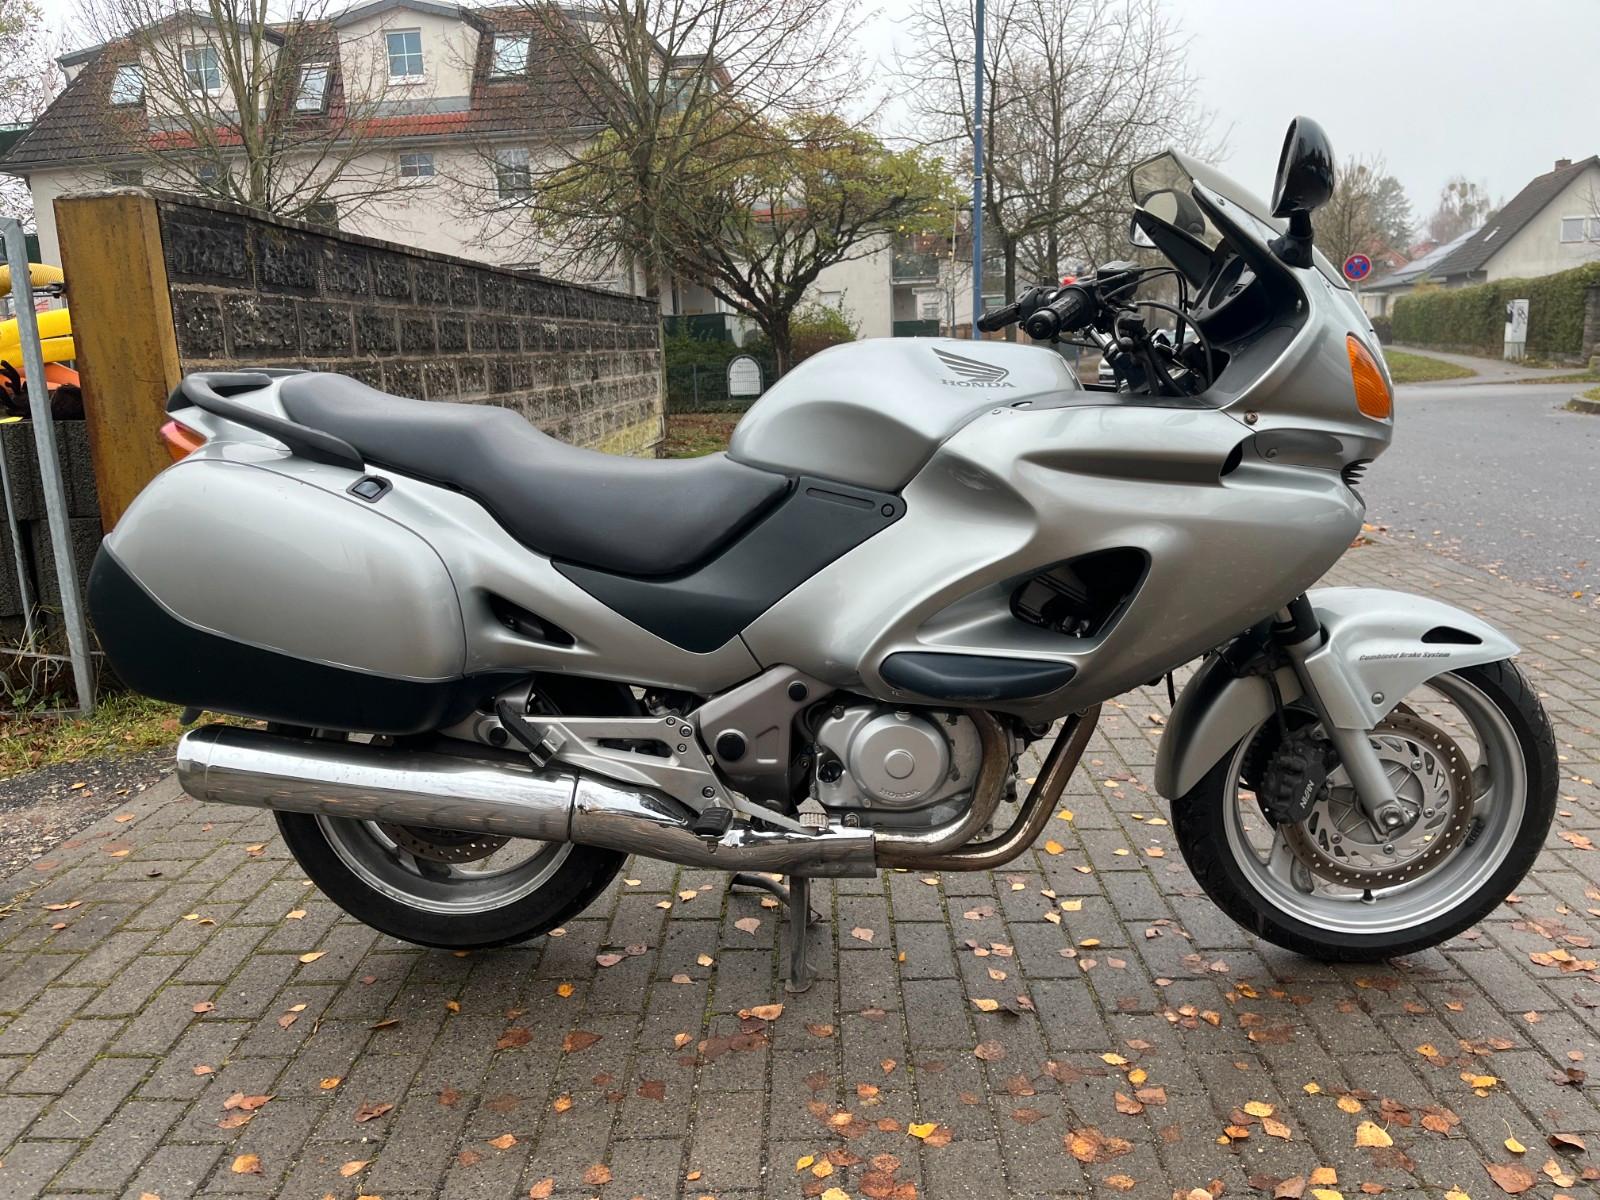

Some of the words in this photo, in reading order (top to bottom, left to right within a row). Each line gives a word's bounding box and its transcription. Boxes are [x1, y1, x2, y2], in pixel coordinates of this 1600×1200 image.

[941, 379, 1016, 388] HONDA
[1359, 652, 1399, 661] Combined
[1399, 651, 1422, 659] Brake
